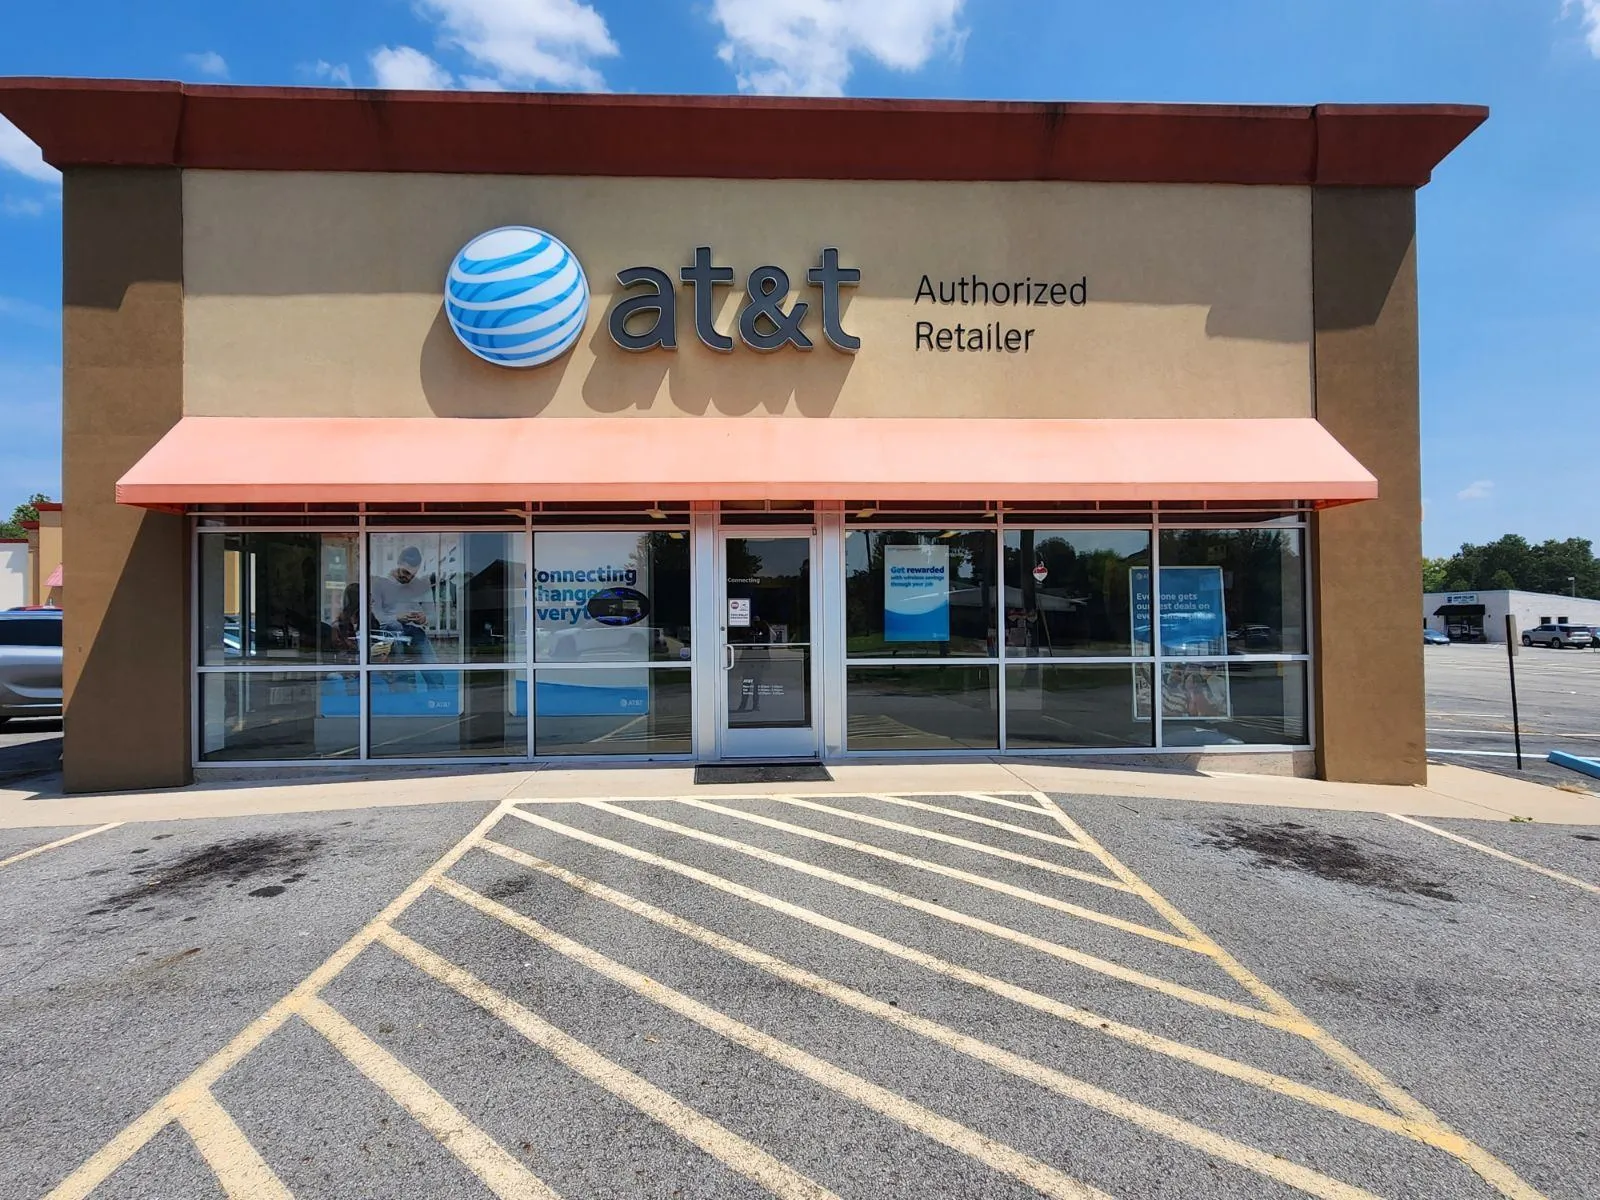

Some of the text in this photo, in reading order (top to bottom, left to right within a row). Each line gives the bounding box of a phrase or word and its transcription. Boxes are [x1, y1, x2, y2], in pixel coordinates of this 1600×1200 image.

[608, 246, 861, 352] at&t
[914, 274, 1087, 306] Authorized
[915, 321, 1035, 352] Retailer
[890, 565, 945, 574] Get rewarded
[525, 585, 602, 606] hange
[1136, 593, 1198, 603] Evone gets
[1174, 602, 1197, 610] deals
